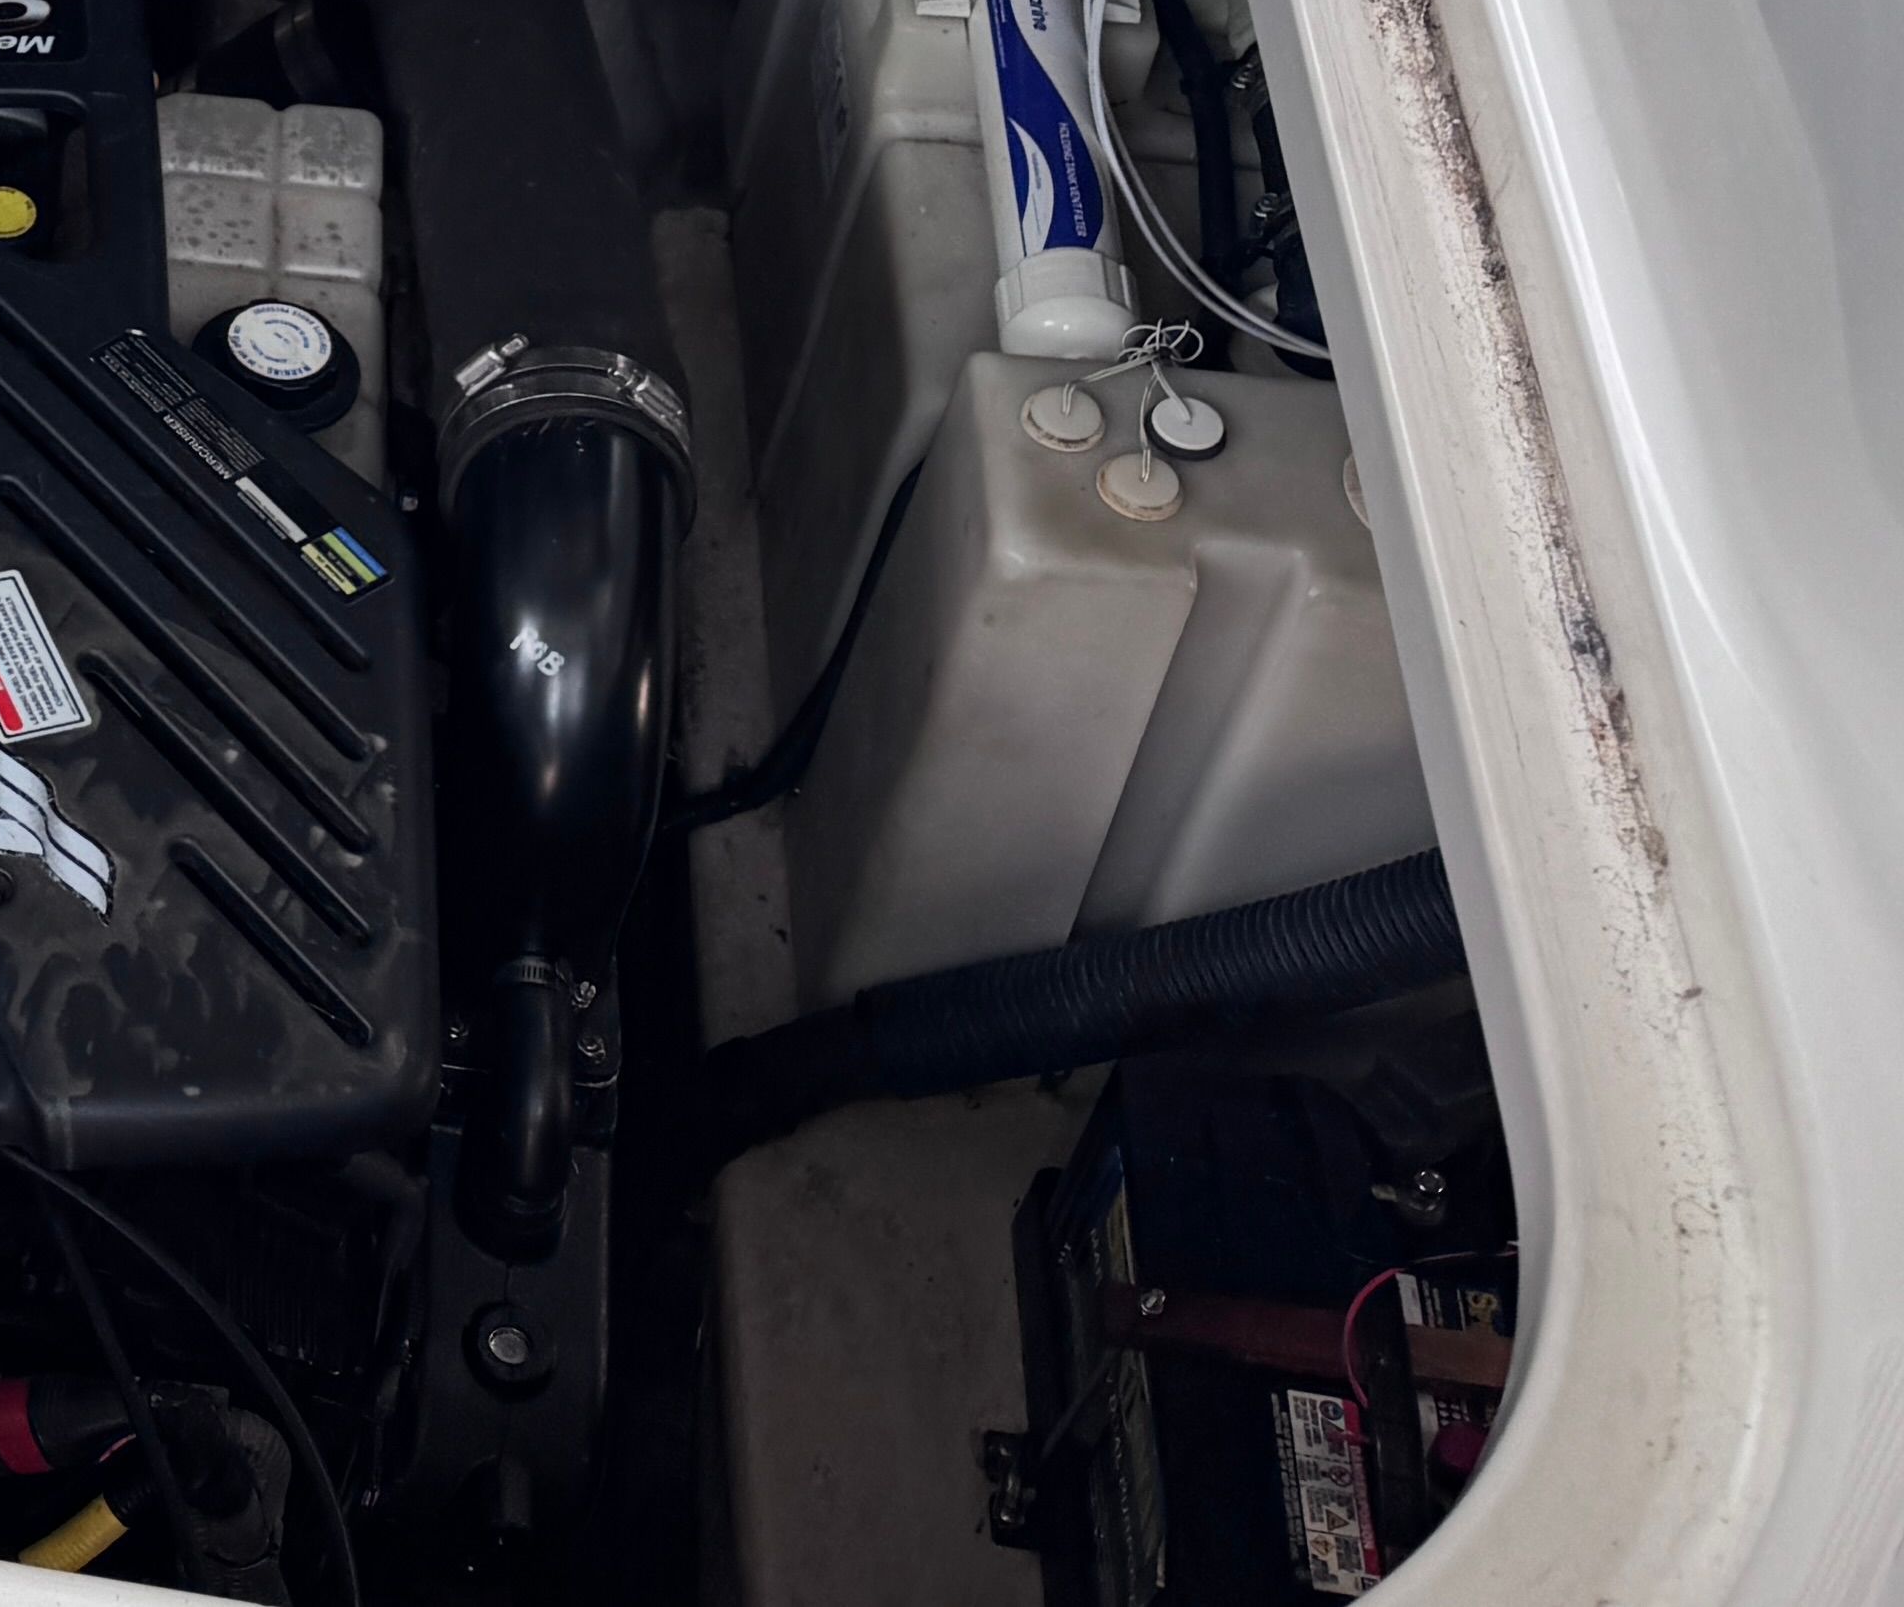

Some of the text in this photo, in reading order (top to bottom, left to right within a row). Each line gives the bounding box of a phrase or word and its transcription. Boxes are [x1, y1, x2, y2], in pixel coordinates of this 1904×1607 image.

[1056, 120, 1088, 238] HOLDING TANK VENT FILTER
[161, 411, 236, 480] MERCRUISER
